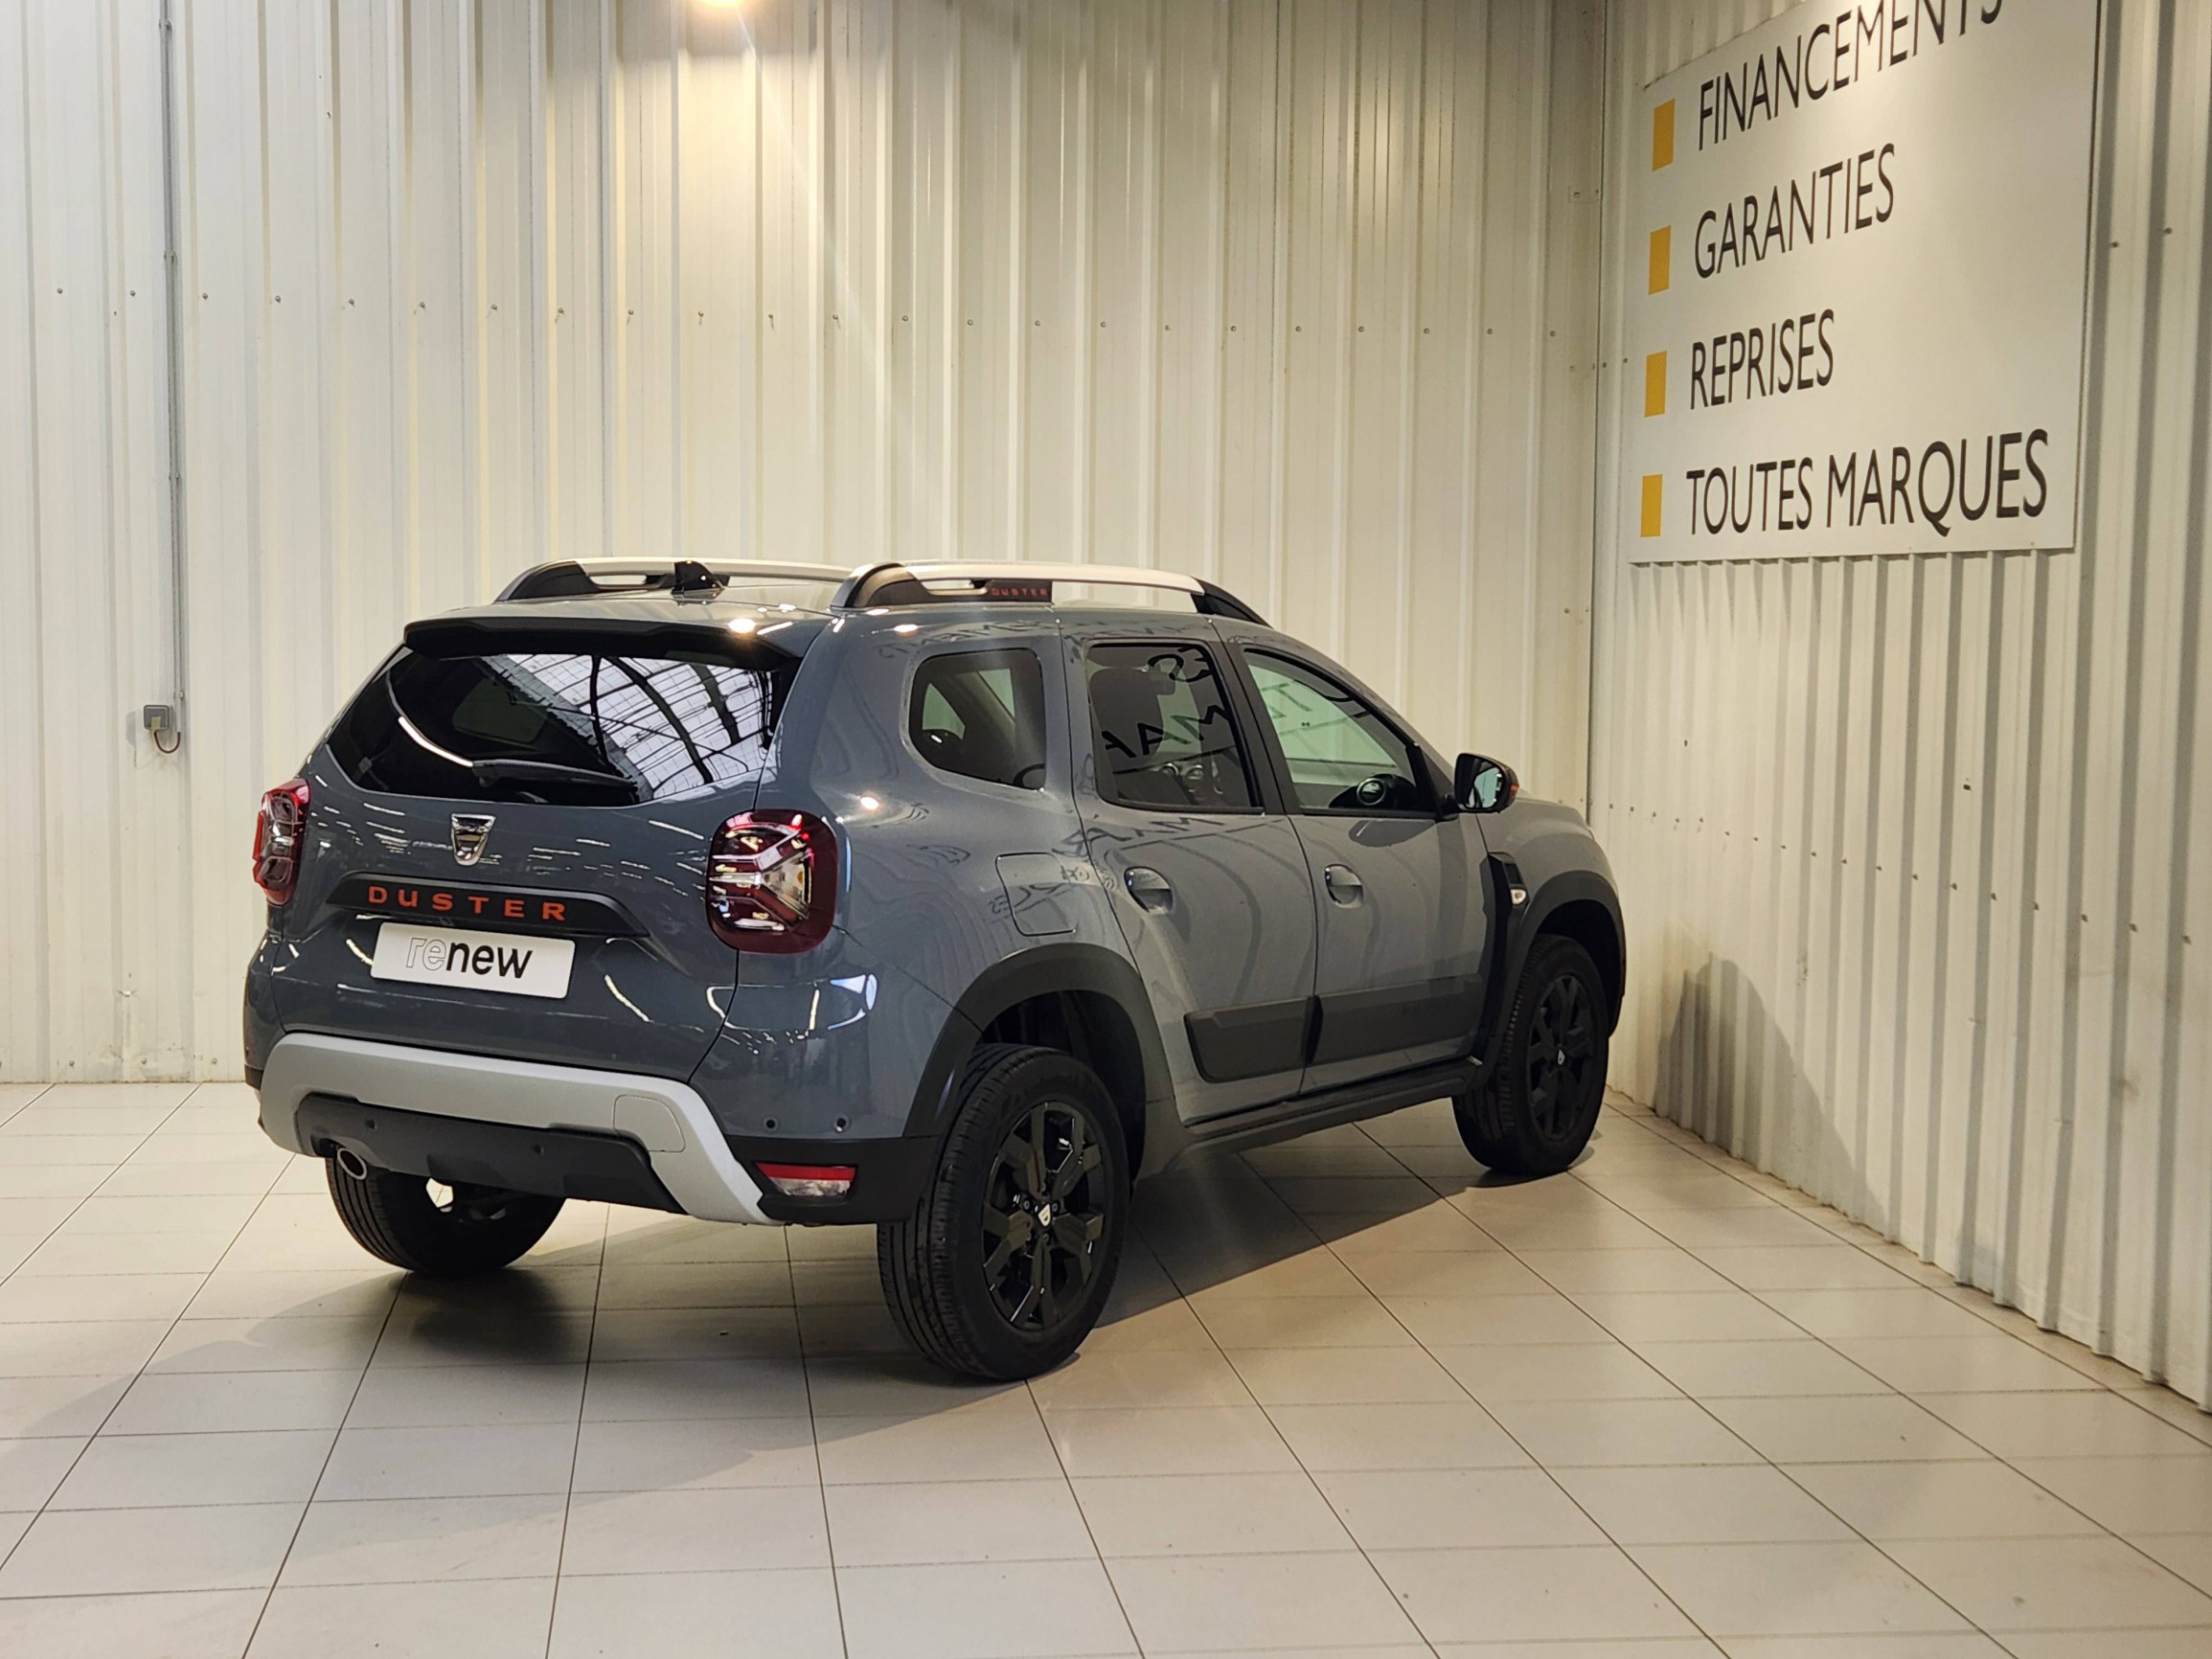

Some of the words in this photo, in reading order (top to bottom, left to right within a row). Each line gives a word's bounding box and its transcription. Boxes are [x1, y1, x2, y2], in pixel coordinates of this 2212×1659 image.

[1694, 143, 1896, 279] GARANTIES
[1690, 308, 1835, 410] REPRISES
[1686, 457, 1813, 535] TOUTES
[1826, 428, 2048, 537] MARQUES
[368, 886, 566, 920] DUSTER
[406, 937, 533, 979] renew
